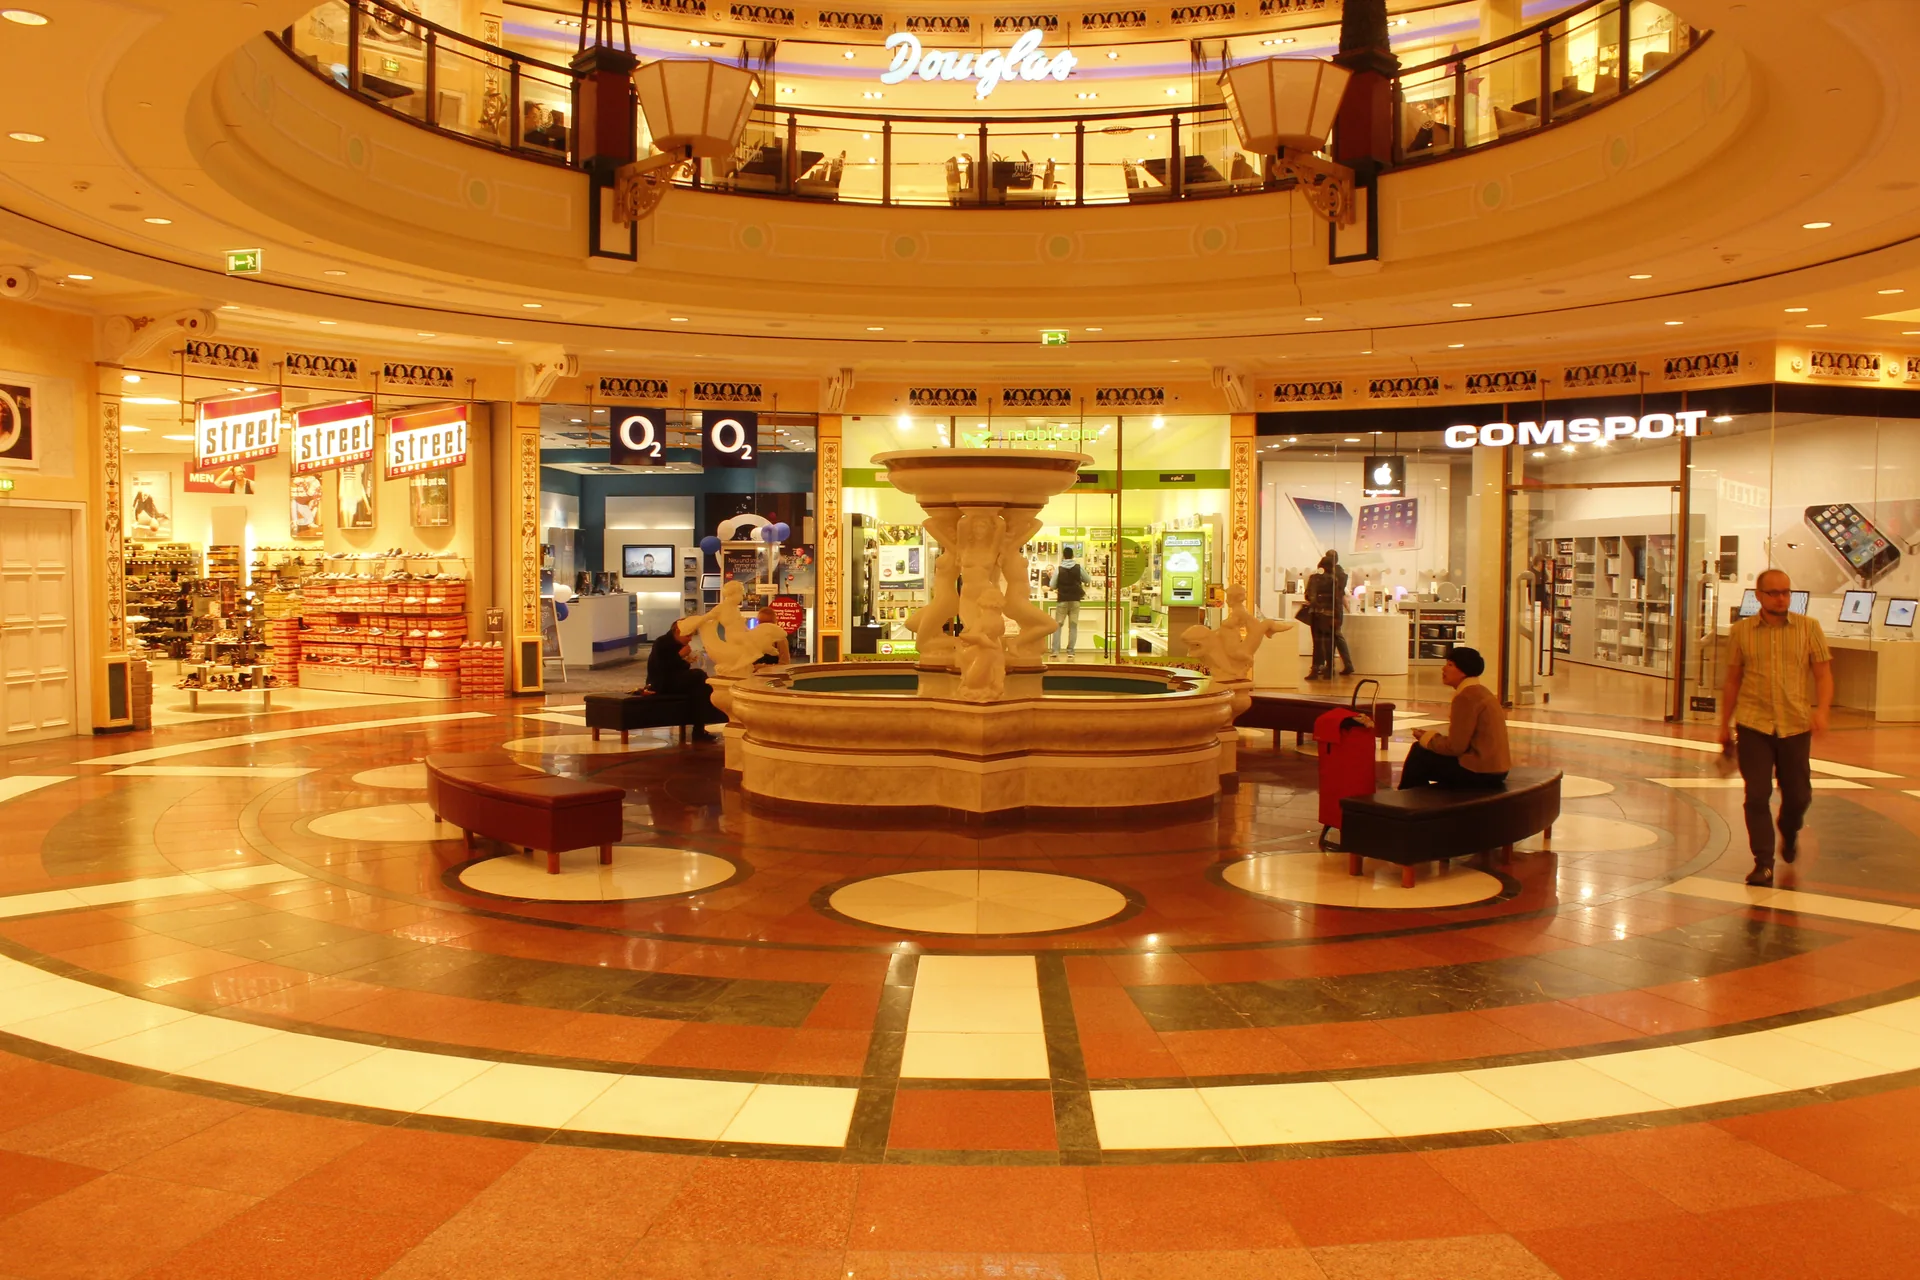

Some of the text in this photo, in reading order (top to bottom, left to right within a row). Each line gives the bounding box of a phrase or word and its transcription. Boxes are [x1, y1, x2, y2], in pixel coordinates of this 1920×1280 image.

[880, 28, 1078, 97] Douglas
[206, 413, 277, 454] street
[301, 419, 370, 460] street
[1008, 426, 1099, 441] mobilcom
[1444, 410, 1707, 448] COMSPOT
[204, 446, 277, 465] SUPER SHOES
[395, 425, 462, 464] street
[300, 450, 371, 471] SUPER SHOES
[393, 455, 464, 475] SUPER SHOES
[189, 473, 215, 483] MEN
